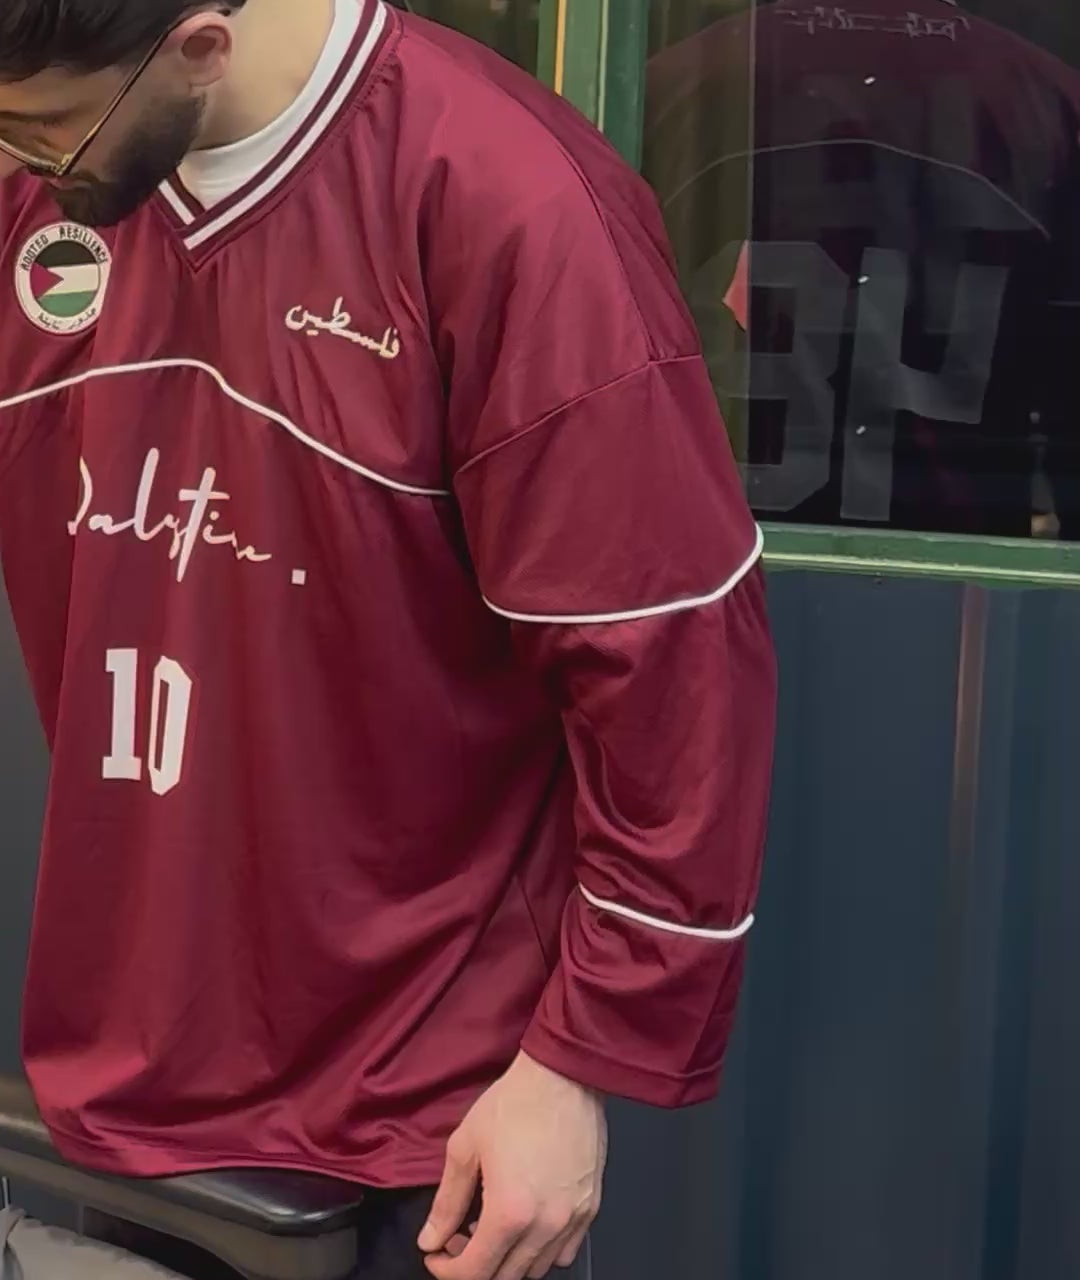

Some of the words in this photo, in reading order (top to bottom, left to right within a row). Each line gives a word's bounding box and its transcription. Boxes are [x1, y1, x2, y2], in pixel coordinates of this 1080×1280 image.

[58, 226, 108, 263] RESILIENCE
[284, 296, 399, 359] فلسطين
[101, 647, 193, 796] 10
